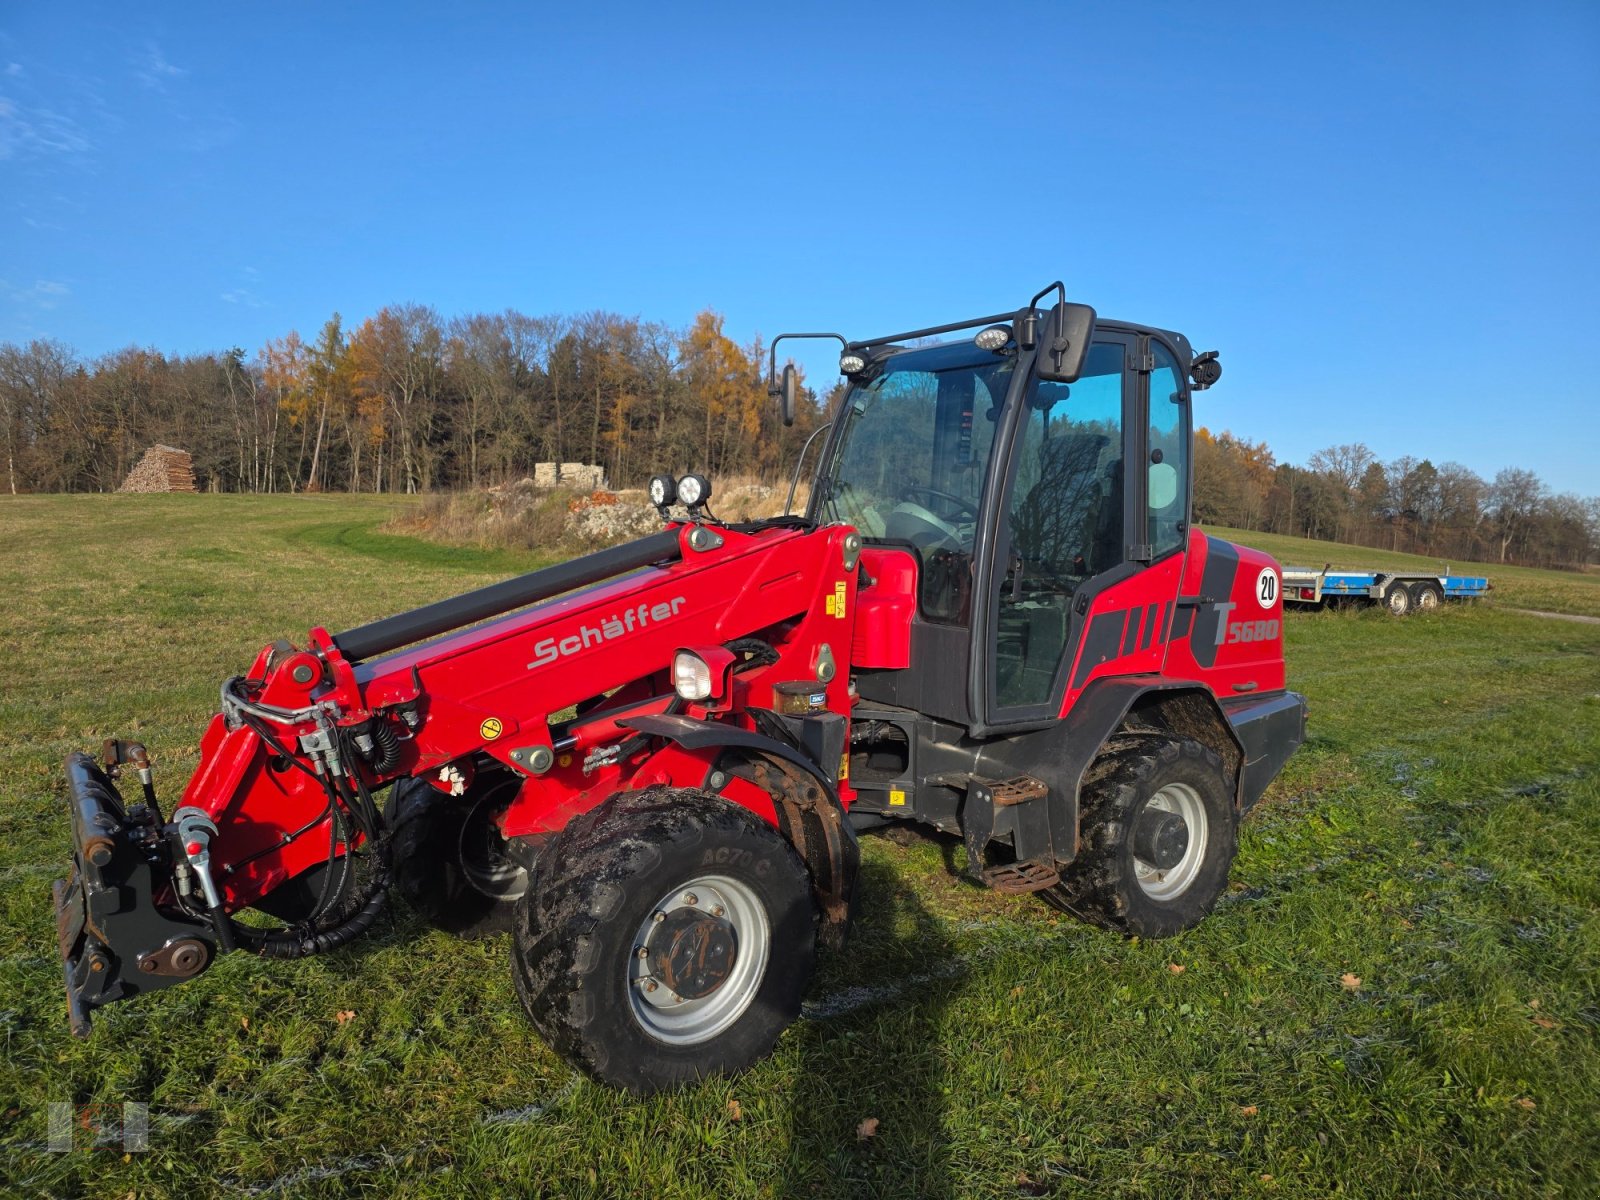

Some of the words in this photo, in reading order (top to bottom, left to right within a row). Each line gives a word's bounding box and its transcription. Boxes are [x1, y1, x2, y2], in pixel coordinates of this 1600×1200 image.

[1261, 576, 1275, 601] 20
[527, 596, 686, 670] Schäffer
[702, 846, 753, 865] AC70
